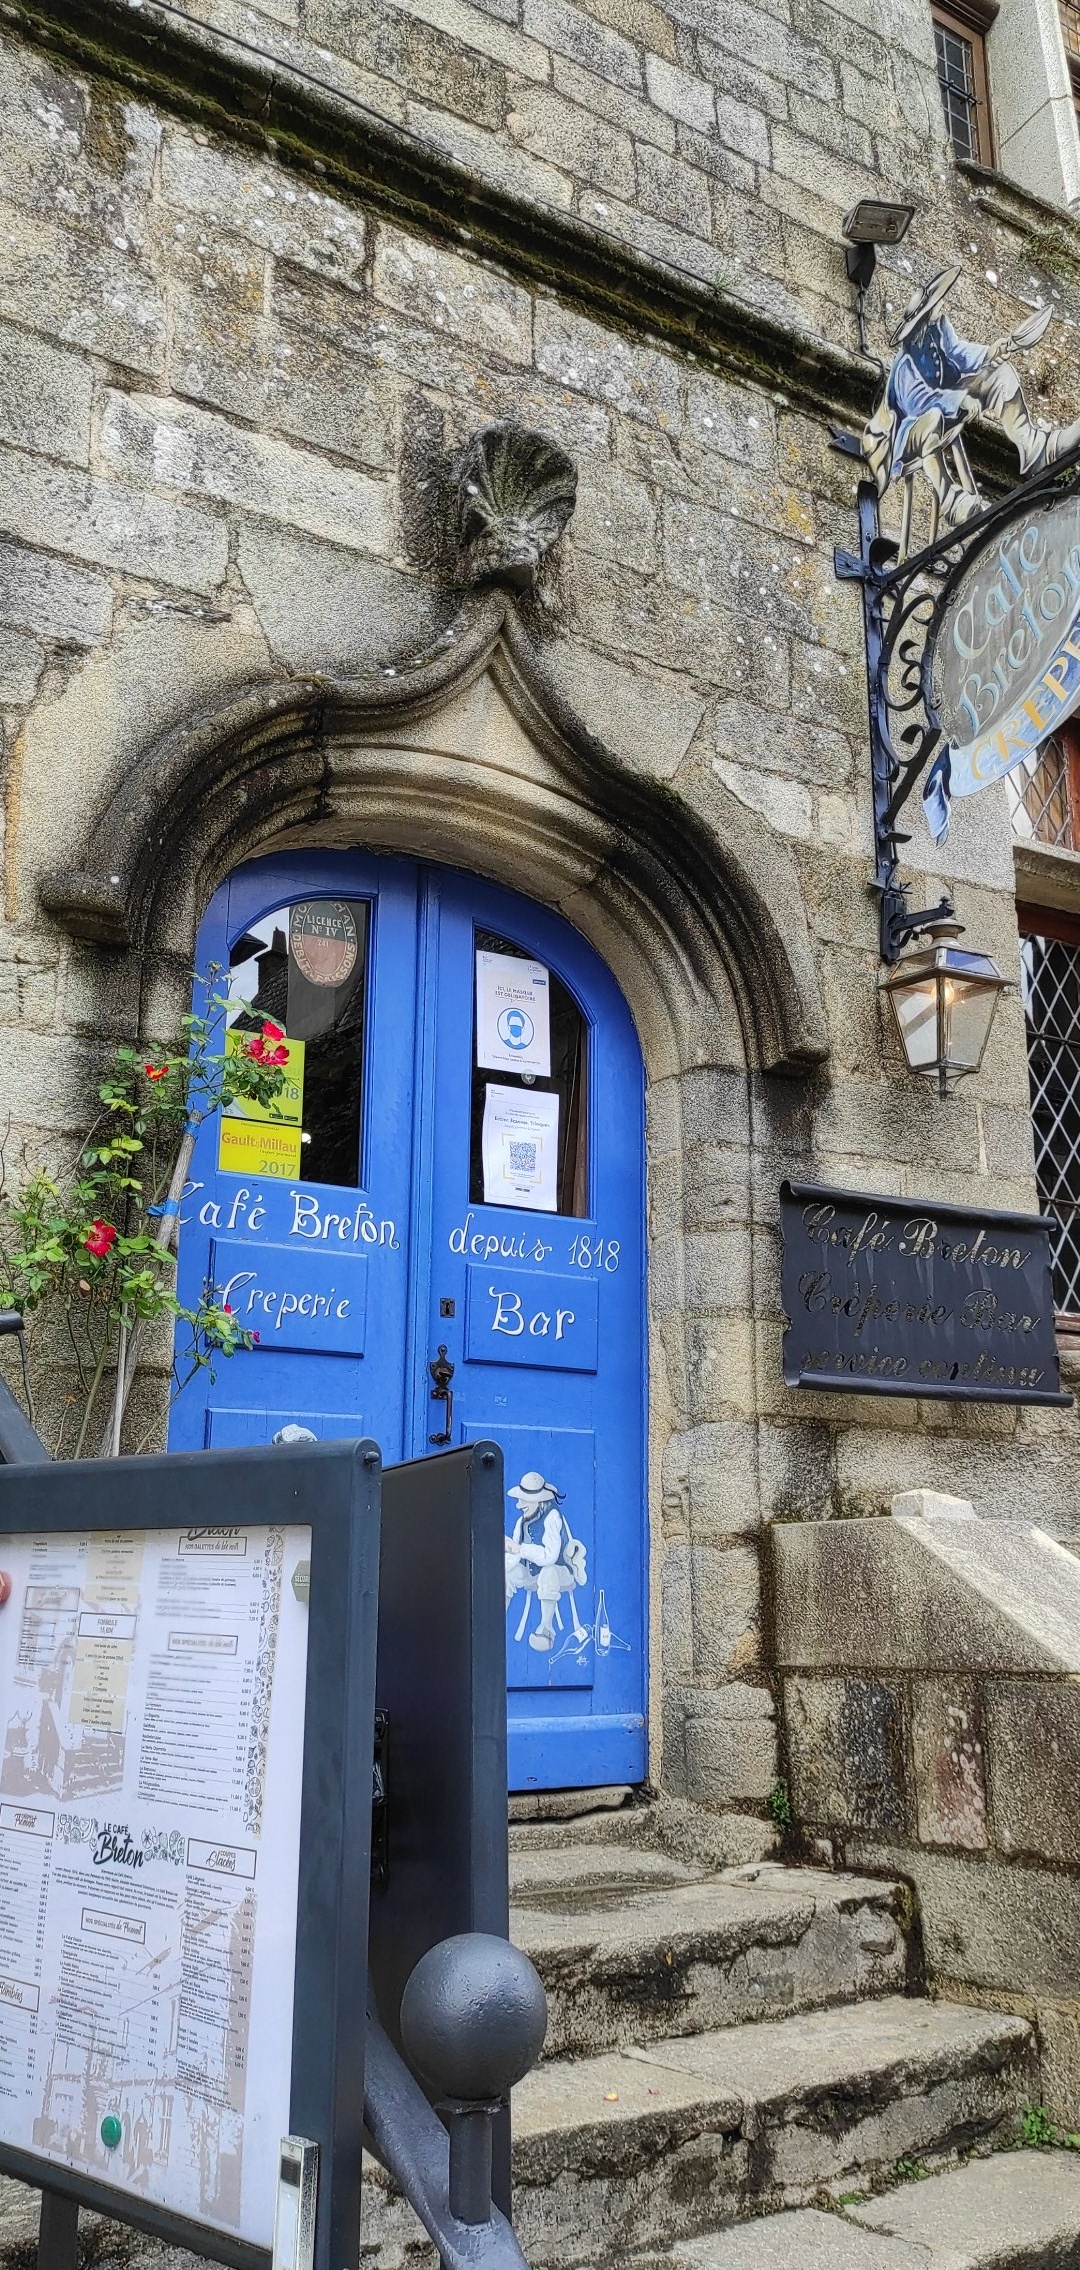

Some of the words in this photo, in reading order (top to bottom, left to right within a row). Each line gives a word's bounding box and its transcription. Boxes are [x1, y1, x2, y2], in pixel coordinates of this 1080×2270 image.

[306, 914, 342, 928] LICENCE
[325, 926, 338, 937] IV
[317, 939, 329, 947] 241
[504, 992, 536, 1001] OBLIGATOIRE
[512, 988, 533, 996] MASQUE
[258, 1160, 296, 1177] 2017
[289, 1190, 400, 1250] Breton
[801, 1202, 894, 1267] Café
[899, 1218, 1031, 1270] Breton
[448, 1212, 552, 1262] depuis
[568, 1234, 621, 1273] 1818
[218, 1271, 352, 1329] Creperie
[488, 1286, 576, 1341] Bar
[960, 1289, 1042, 1334] Bar
[801, 1346, 911, 1377] service
[918, 1349, 1045, 1387] continu
[103, 1822, 111, 1832] LE
[112, 1823, 130, 1835] CAFÉ
[93, 1831, 144, 1869] Breton
